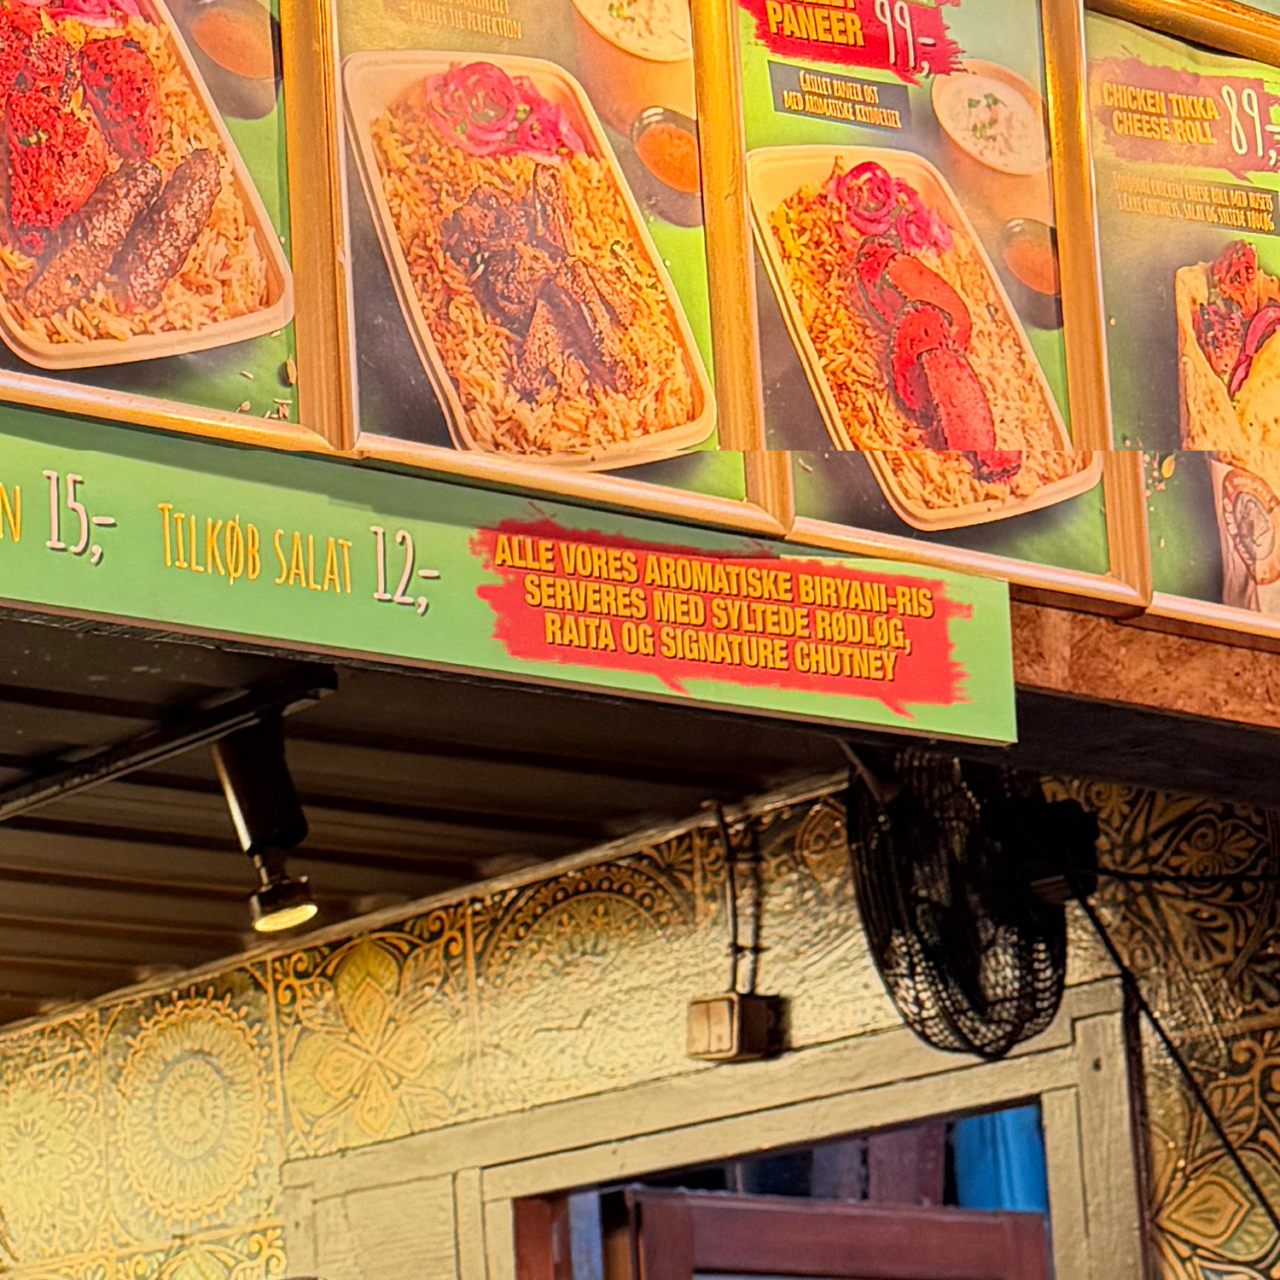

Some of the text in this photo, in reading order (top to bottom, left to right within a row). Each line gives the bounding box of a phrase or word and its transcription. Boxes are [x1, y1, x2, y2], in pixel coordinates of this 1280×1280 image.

[466, 11, 521, 39] PERFEKTION
[765, 1, 866, 47] PANEER
[1102, 82, 1221, 120] CHICKEN TIKKA
[1112, 110, 1218, 144] CHEESE ROLL
[157, 503, 352, 594] TILKØB SALAT
[494, 534, 934, 618] ALLE VORES AROMATISKE BIRYANI-RIS
[524, 573, 912, 656] SERVERES MED SYLTEDE RØDLØG,
[544, 612, 897, 682] RAITA OG SIGNATURE CHUTNEY
